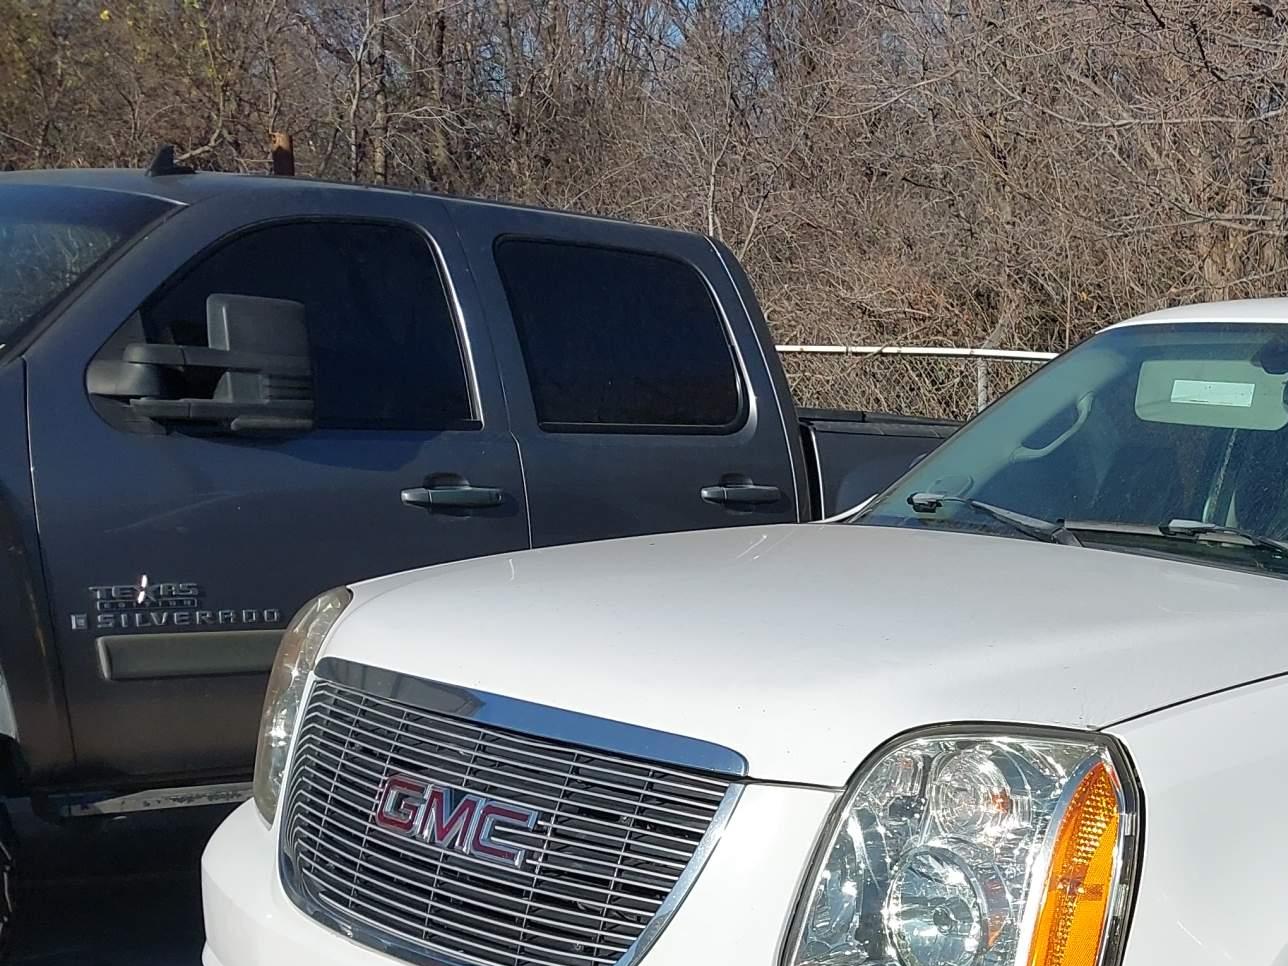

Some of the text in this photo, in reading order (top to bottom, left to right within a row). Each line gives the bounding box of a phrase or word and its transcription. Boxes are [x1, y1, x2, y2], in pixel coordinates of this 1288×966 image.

[88, 574, 200, 604] TEXAS
[97, 608, 281, 629] SILVERADO
[375, 775, 539, 869] GMC
